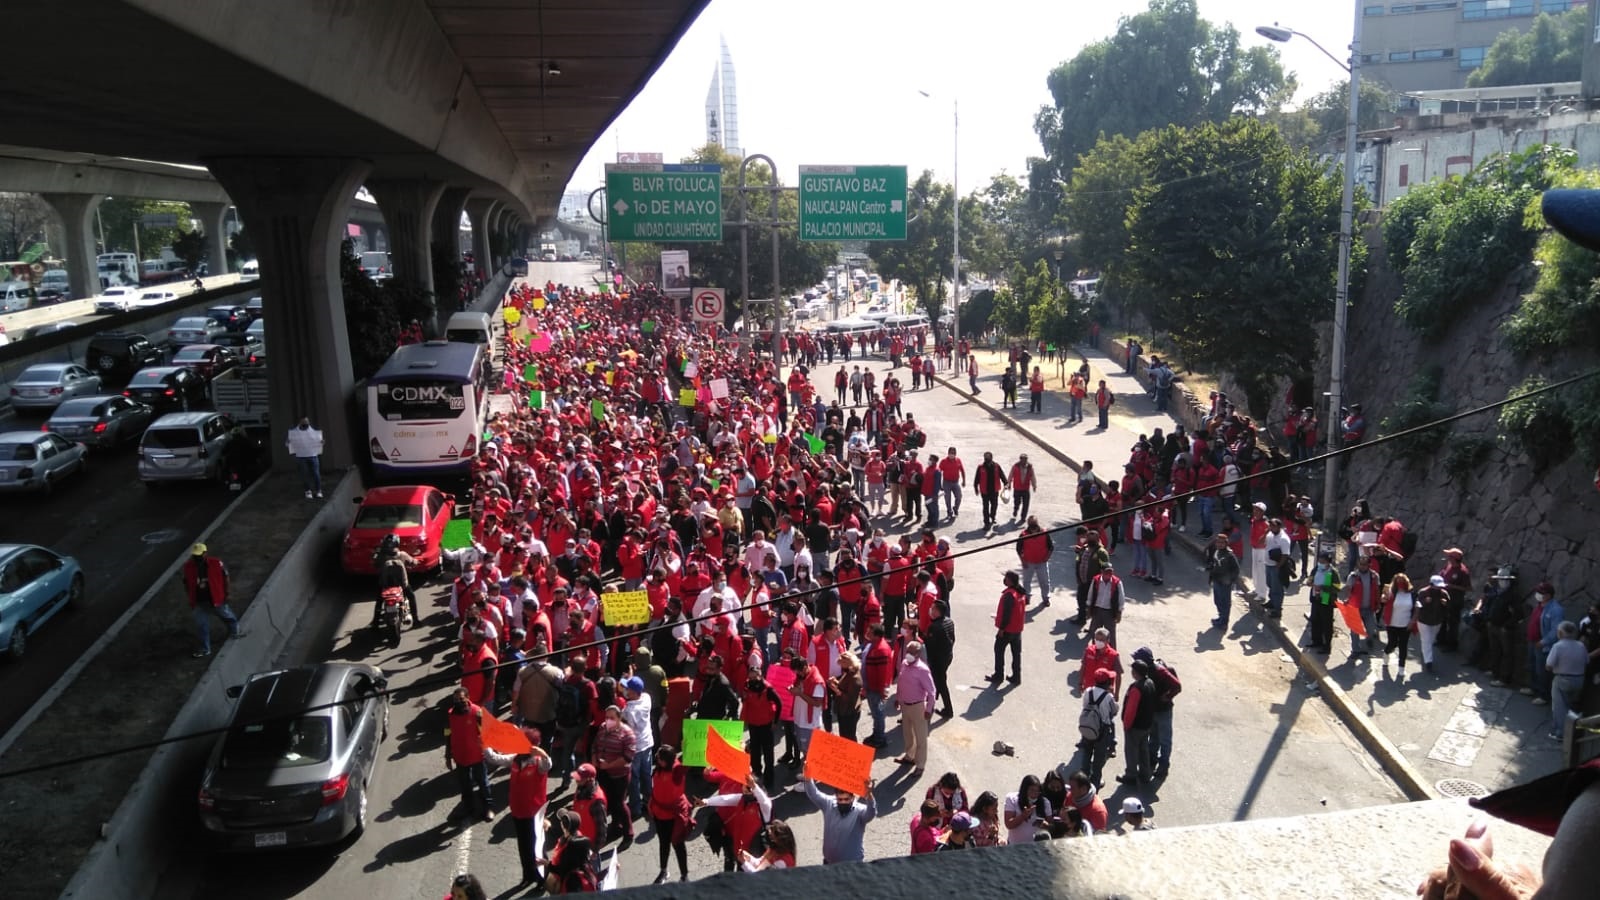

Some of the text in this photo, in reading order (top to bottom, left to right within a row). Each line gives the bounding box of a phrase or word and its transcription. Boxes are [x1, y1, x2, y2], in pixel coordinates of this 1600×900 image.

[633, 177, 716, 192] BLVR TOLUCA
[804, 178, 887, 193] GUSTAVO BAZ
[651, 200, 670, 214] DE
[674, 200, 717, 215] MAYO
[804, 200, 887, 214] NAUCALPAN Centro
[633, 219, 717, 237] UNIDAD CUAUHTÉMOC
[805, 221, 887, 236] PALACIO MUNICIPAL
[702, 296, 715, 314] E
[391, 386, 447, 401] CDMX
